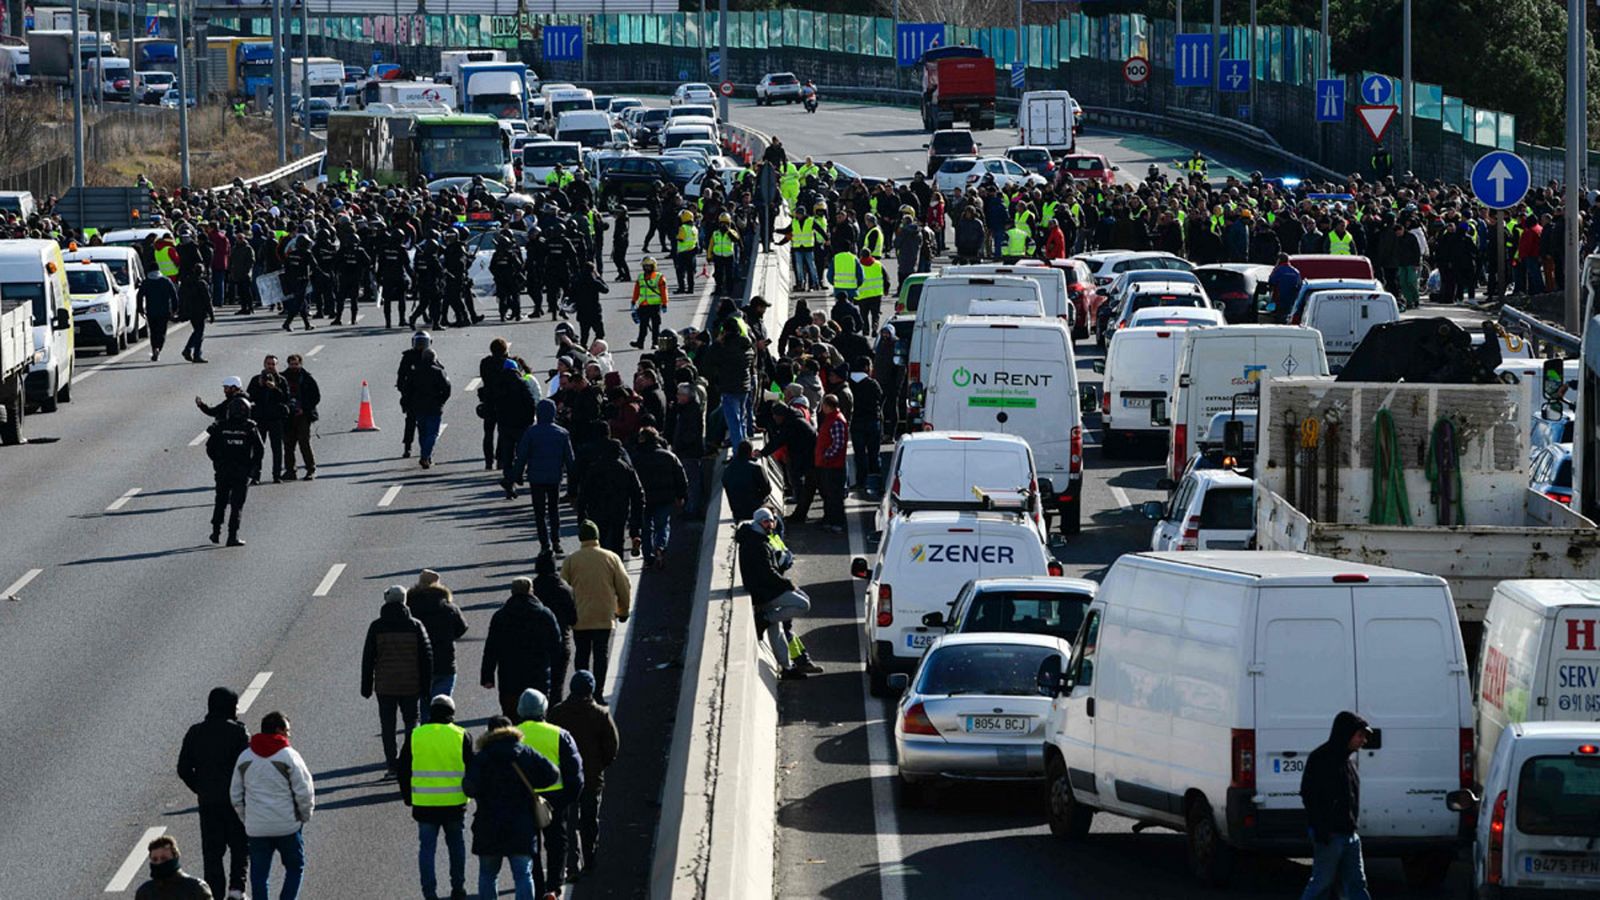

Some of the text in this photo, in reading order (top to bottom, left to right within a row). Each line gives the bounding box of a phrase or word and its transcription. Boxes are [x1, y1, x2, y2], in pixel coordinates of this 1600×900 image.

[1127, 65, 1146, 75] 100
[952, 366, 1052, 387] ON RENT
[928, 544, 1014, 564] ZENER
[1566, 618, 1600, 651] H
[974, 718, 1026, 730] 8054 BCJ
[1282, 760, 1304, 772] 230
[1533, 858, 1567, 872] 9475
